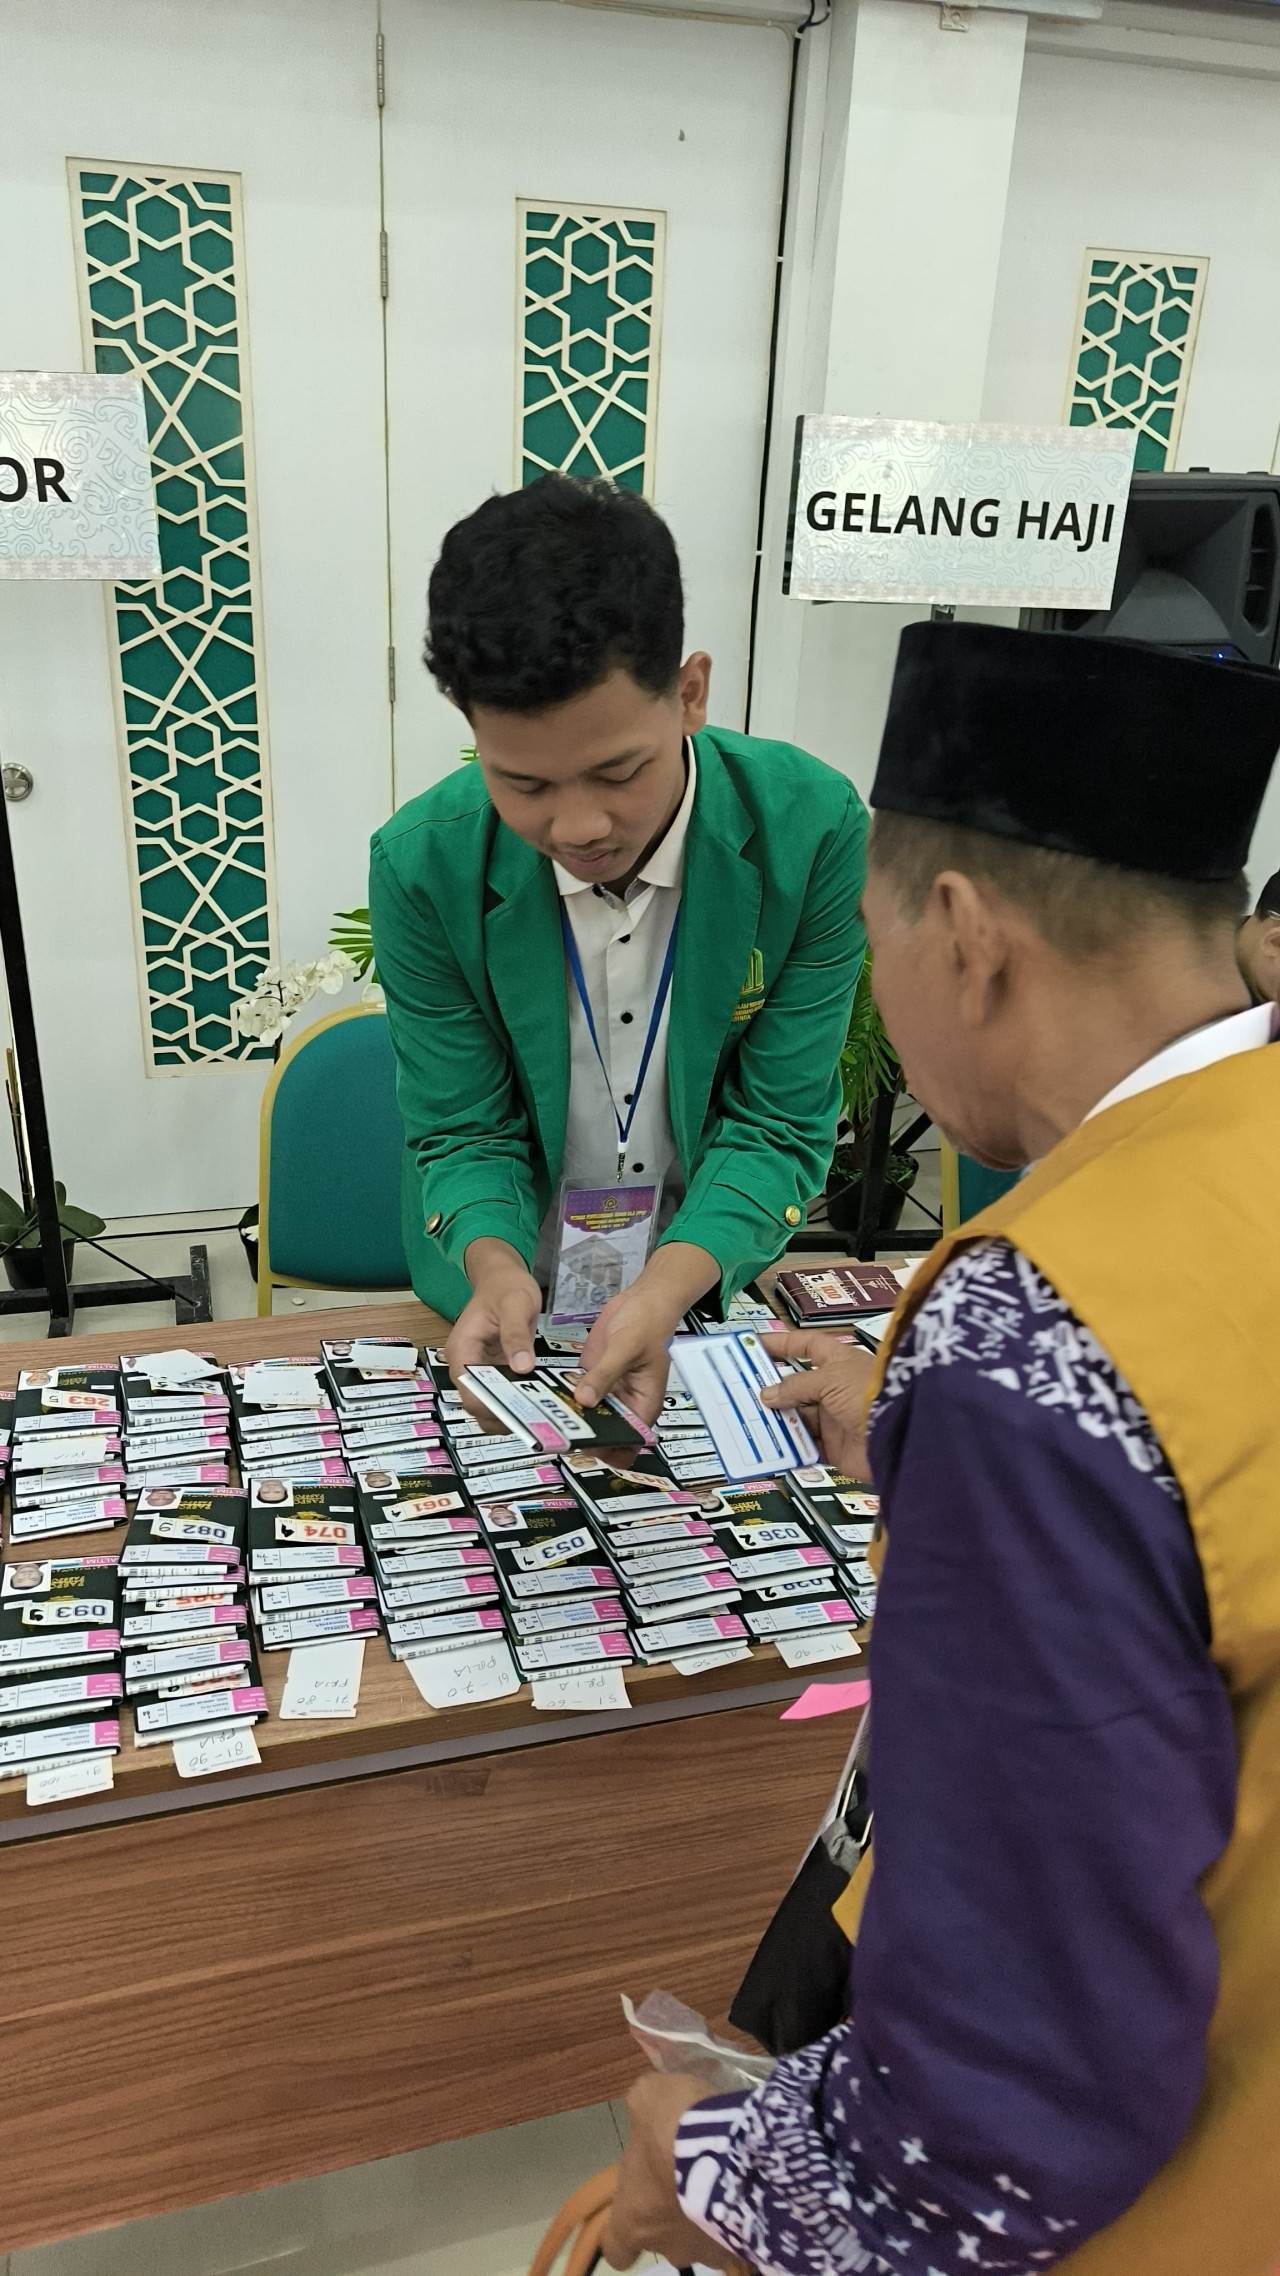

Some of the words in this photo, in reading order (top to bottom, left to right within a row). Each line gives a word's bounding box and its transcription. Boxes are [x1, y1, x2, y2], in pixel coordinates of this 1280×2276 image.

[0, 457, 72, 502] OR
[806, 491, 1000, 539] GELANG
[1017, 500, 1115, 552] HAJI
[68, 1396, 109, 1406] 263
[412, 1498, 452, 1512] 061
[183, 1525, 226, 1538] 082
[304, 1525, 347, 1538] 074
[758, 1528, 800, 1541] 036
[739, 1534, 756, 1546] 2
[541, 1536, 585, 1559] 053
[57, 1605, 106, 1618] 093
[498, 1672, 509, 1685] 61
[447, 1681, 474, 1698] 70
[297, 1695, 317, 1705] 80
[547, 1699, 566, 1708] 60
[228, 1742, 243, 1758] 81
[188, 1753, 208, 1767] 90
